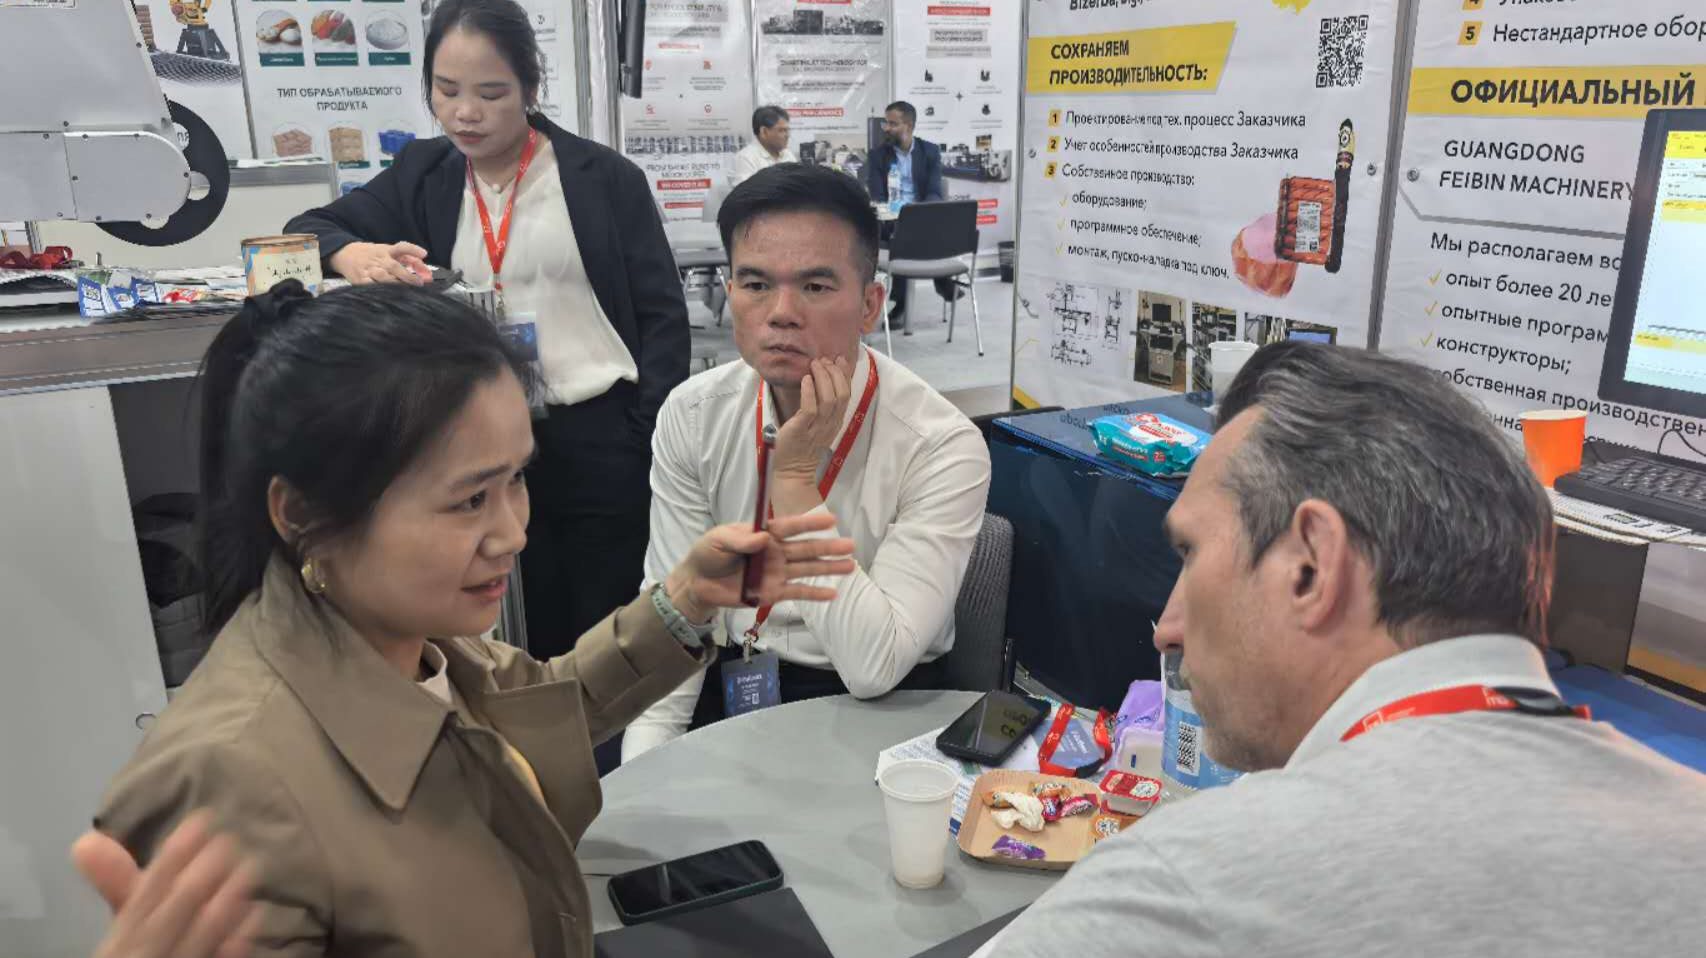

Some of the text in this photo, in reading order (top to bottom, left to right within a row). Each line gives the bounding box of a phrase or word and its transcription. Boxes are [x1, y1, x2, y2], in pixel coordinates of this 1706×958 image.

[1465, 26, 1476, 41] 5
[1493, 22, 1648, 46] Нестандартное
[1050, 40, 1130, 60] СОХРАНЯЕМ
[1050, 64, 1209, 87] ПРОИЗВОДИТЕЛЬНОСТЬ:
[276, 86, 402, 98] ТИП ОБРАБАТЫВАЕМОГО
[1450, 72, 1696, 109] ОФИЦИАЛЬНЫЙ
[316, 100, 369, 112] ПРОДУКТА
[1052, 110, 1306, 131] 1 Проектирование под тех. процесс Заказчика
[1050, 137, 1298, 160] 2 Учет особенностей производства Заказчика
[1444, 139, 1585, 164] GUANGDONG
[1047, 163, 1195, 187] 3 Собственное производство:
[1439, 171, 1633, 201] FEIBIN MACHINERY
[1072, 191, 1147, 210] оборудование;
[1070, 218, 1202, 248] программное обеспечение;
[1068, 245, 1230, 280] монтаж, пуско-наладка под ключ.
[1430, 232, 1462, 252] Мы
[1467, 238, 1593, 268] располагаем
[1446, 271, 1492, 290] опыт
[1496, 274, 1553, 299] более
[1558, 282, 1582, 302] 20
[1441, 303, 1608, 345] опытные програм
[1436, 335, 1571, 375] конструкторы;
[1440, 368, 1547, 402] обственная
